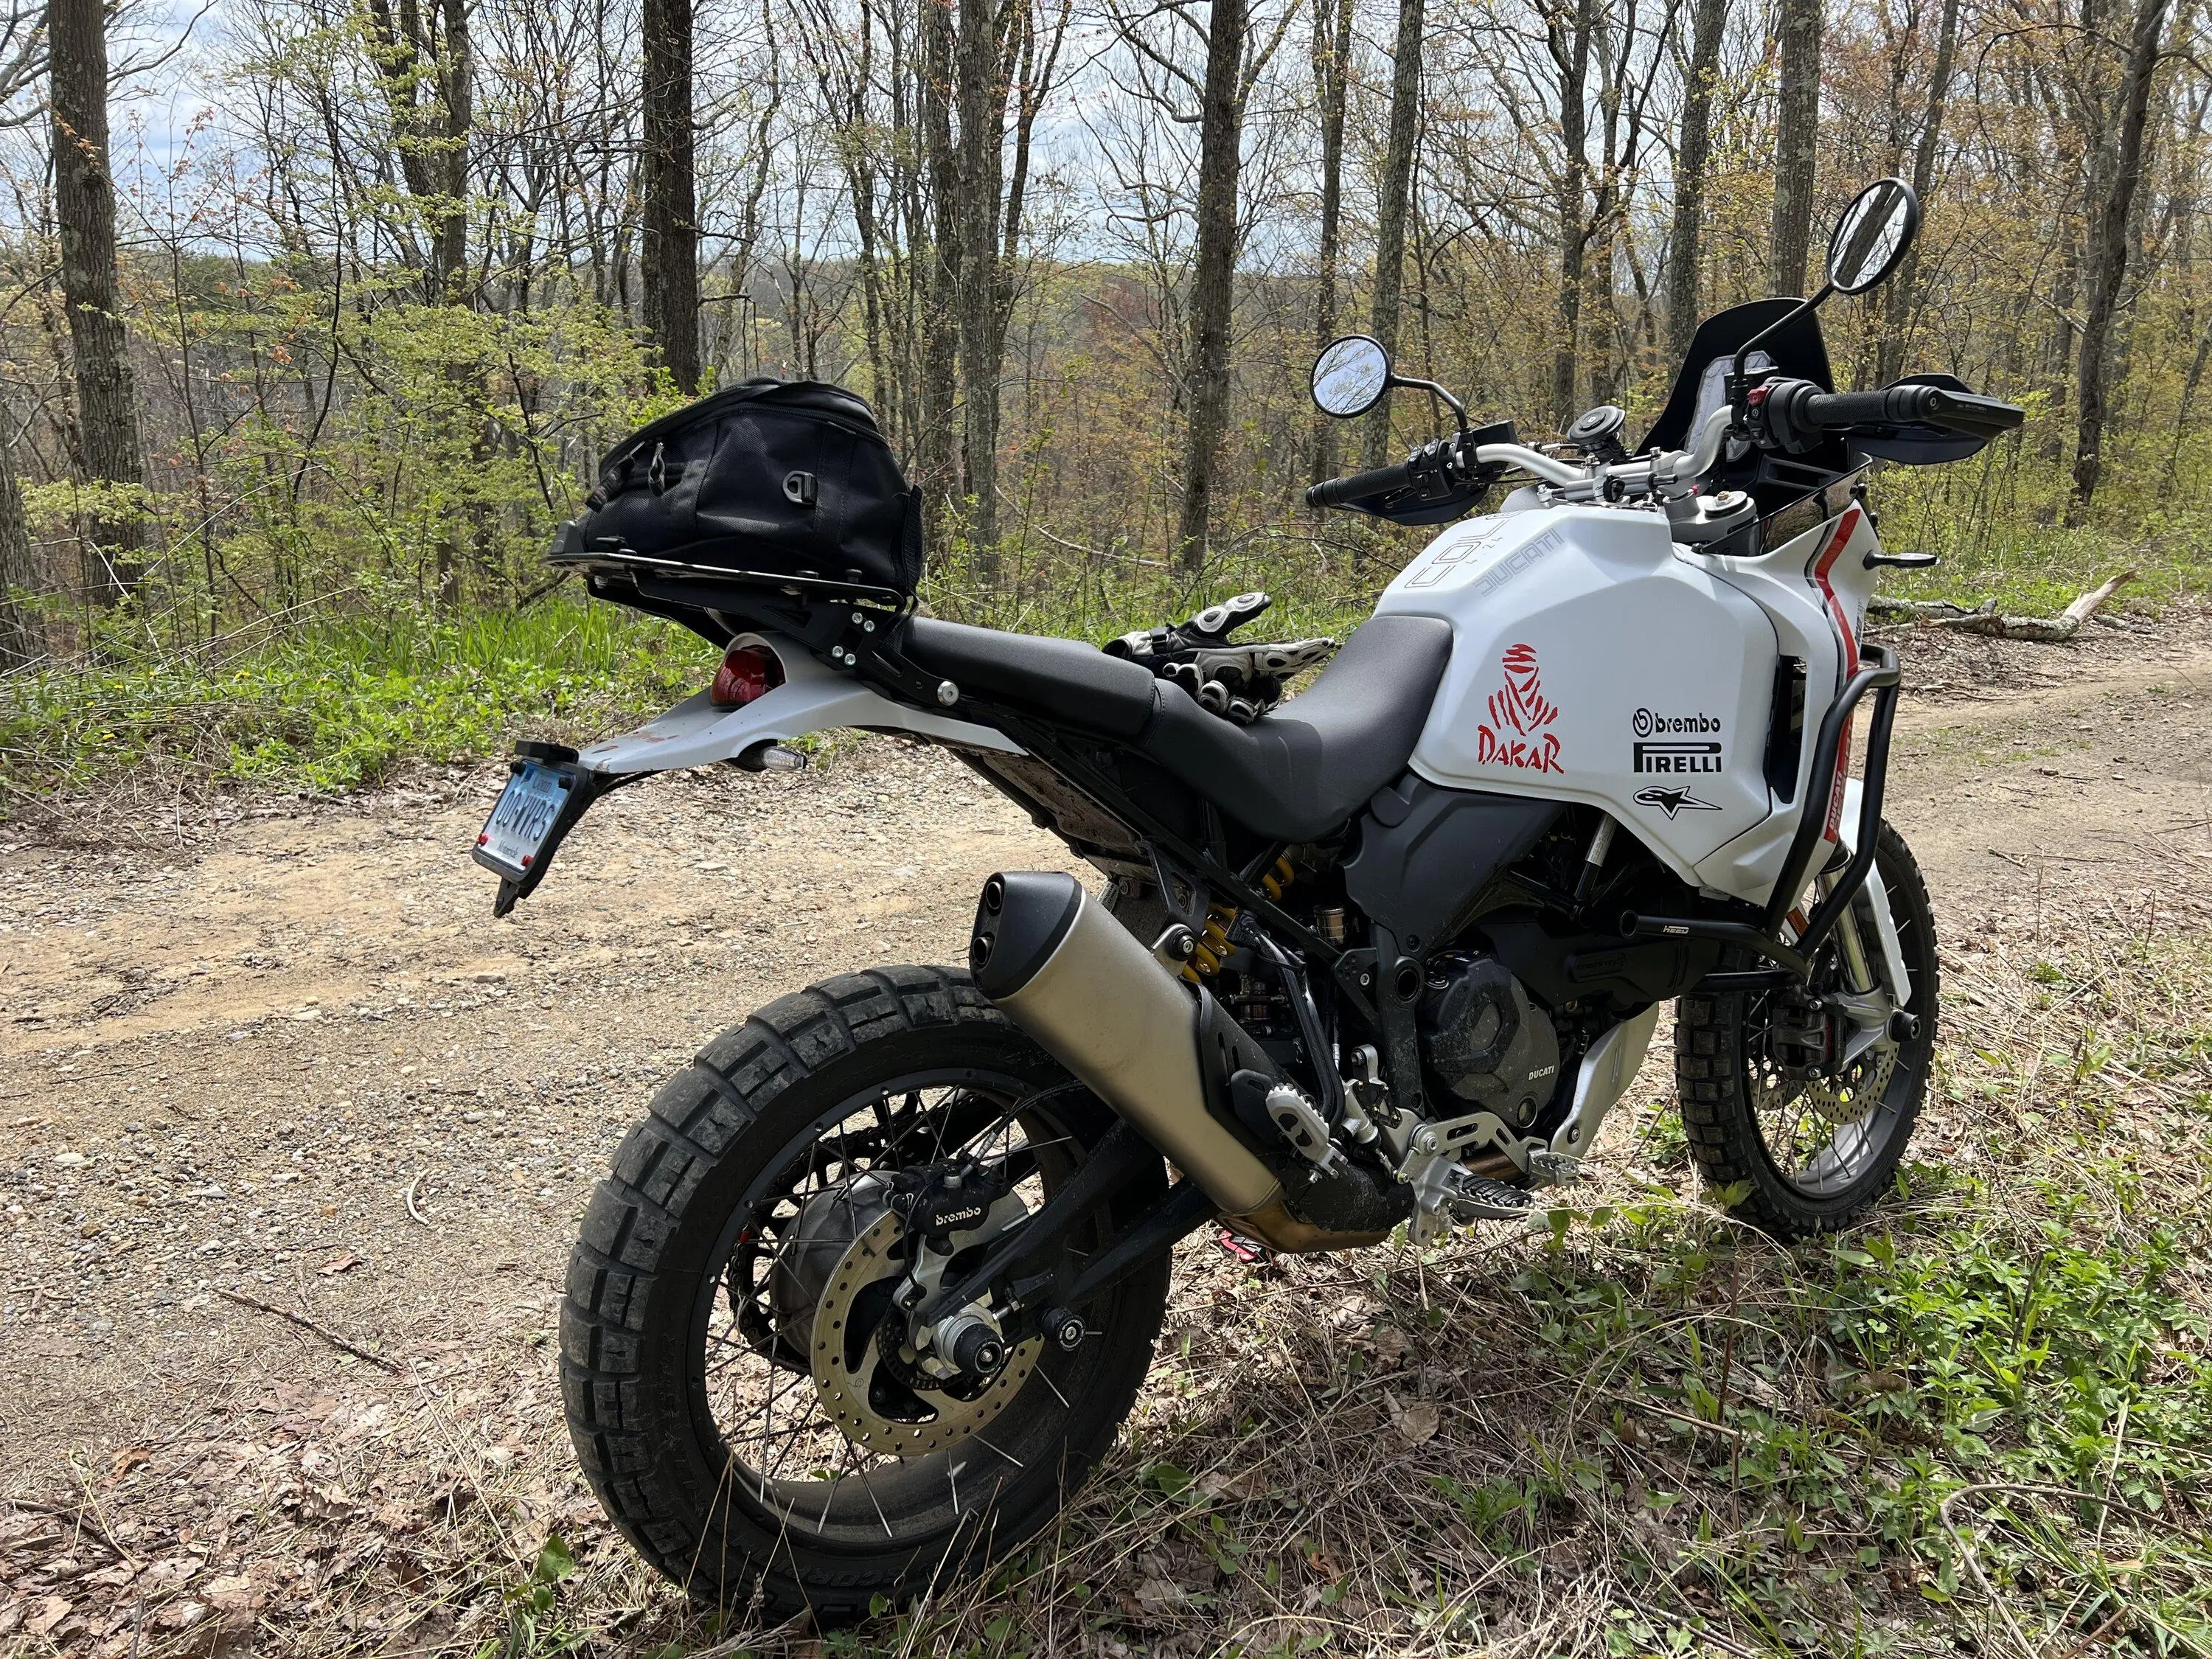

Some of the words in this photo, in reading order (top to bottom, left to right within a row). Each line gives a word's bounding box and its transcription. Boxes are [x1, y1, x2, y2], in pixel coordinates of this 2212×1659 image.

[1475, 528, 1565, 597] DUCATI
[1655, 712, 1721, 733] brembo
[1477, 725, 1565, 775] DAKAR
[1632, 741, 1722, 773] PIRELLI
[1828, 771, 1843, 832] DUCATI
[1528, 1065, 1555, 1082] DUCATI
[935, 1206, 981, 1226] brembo
